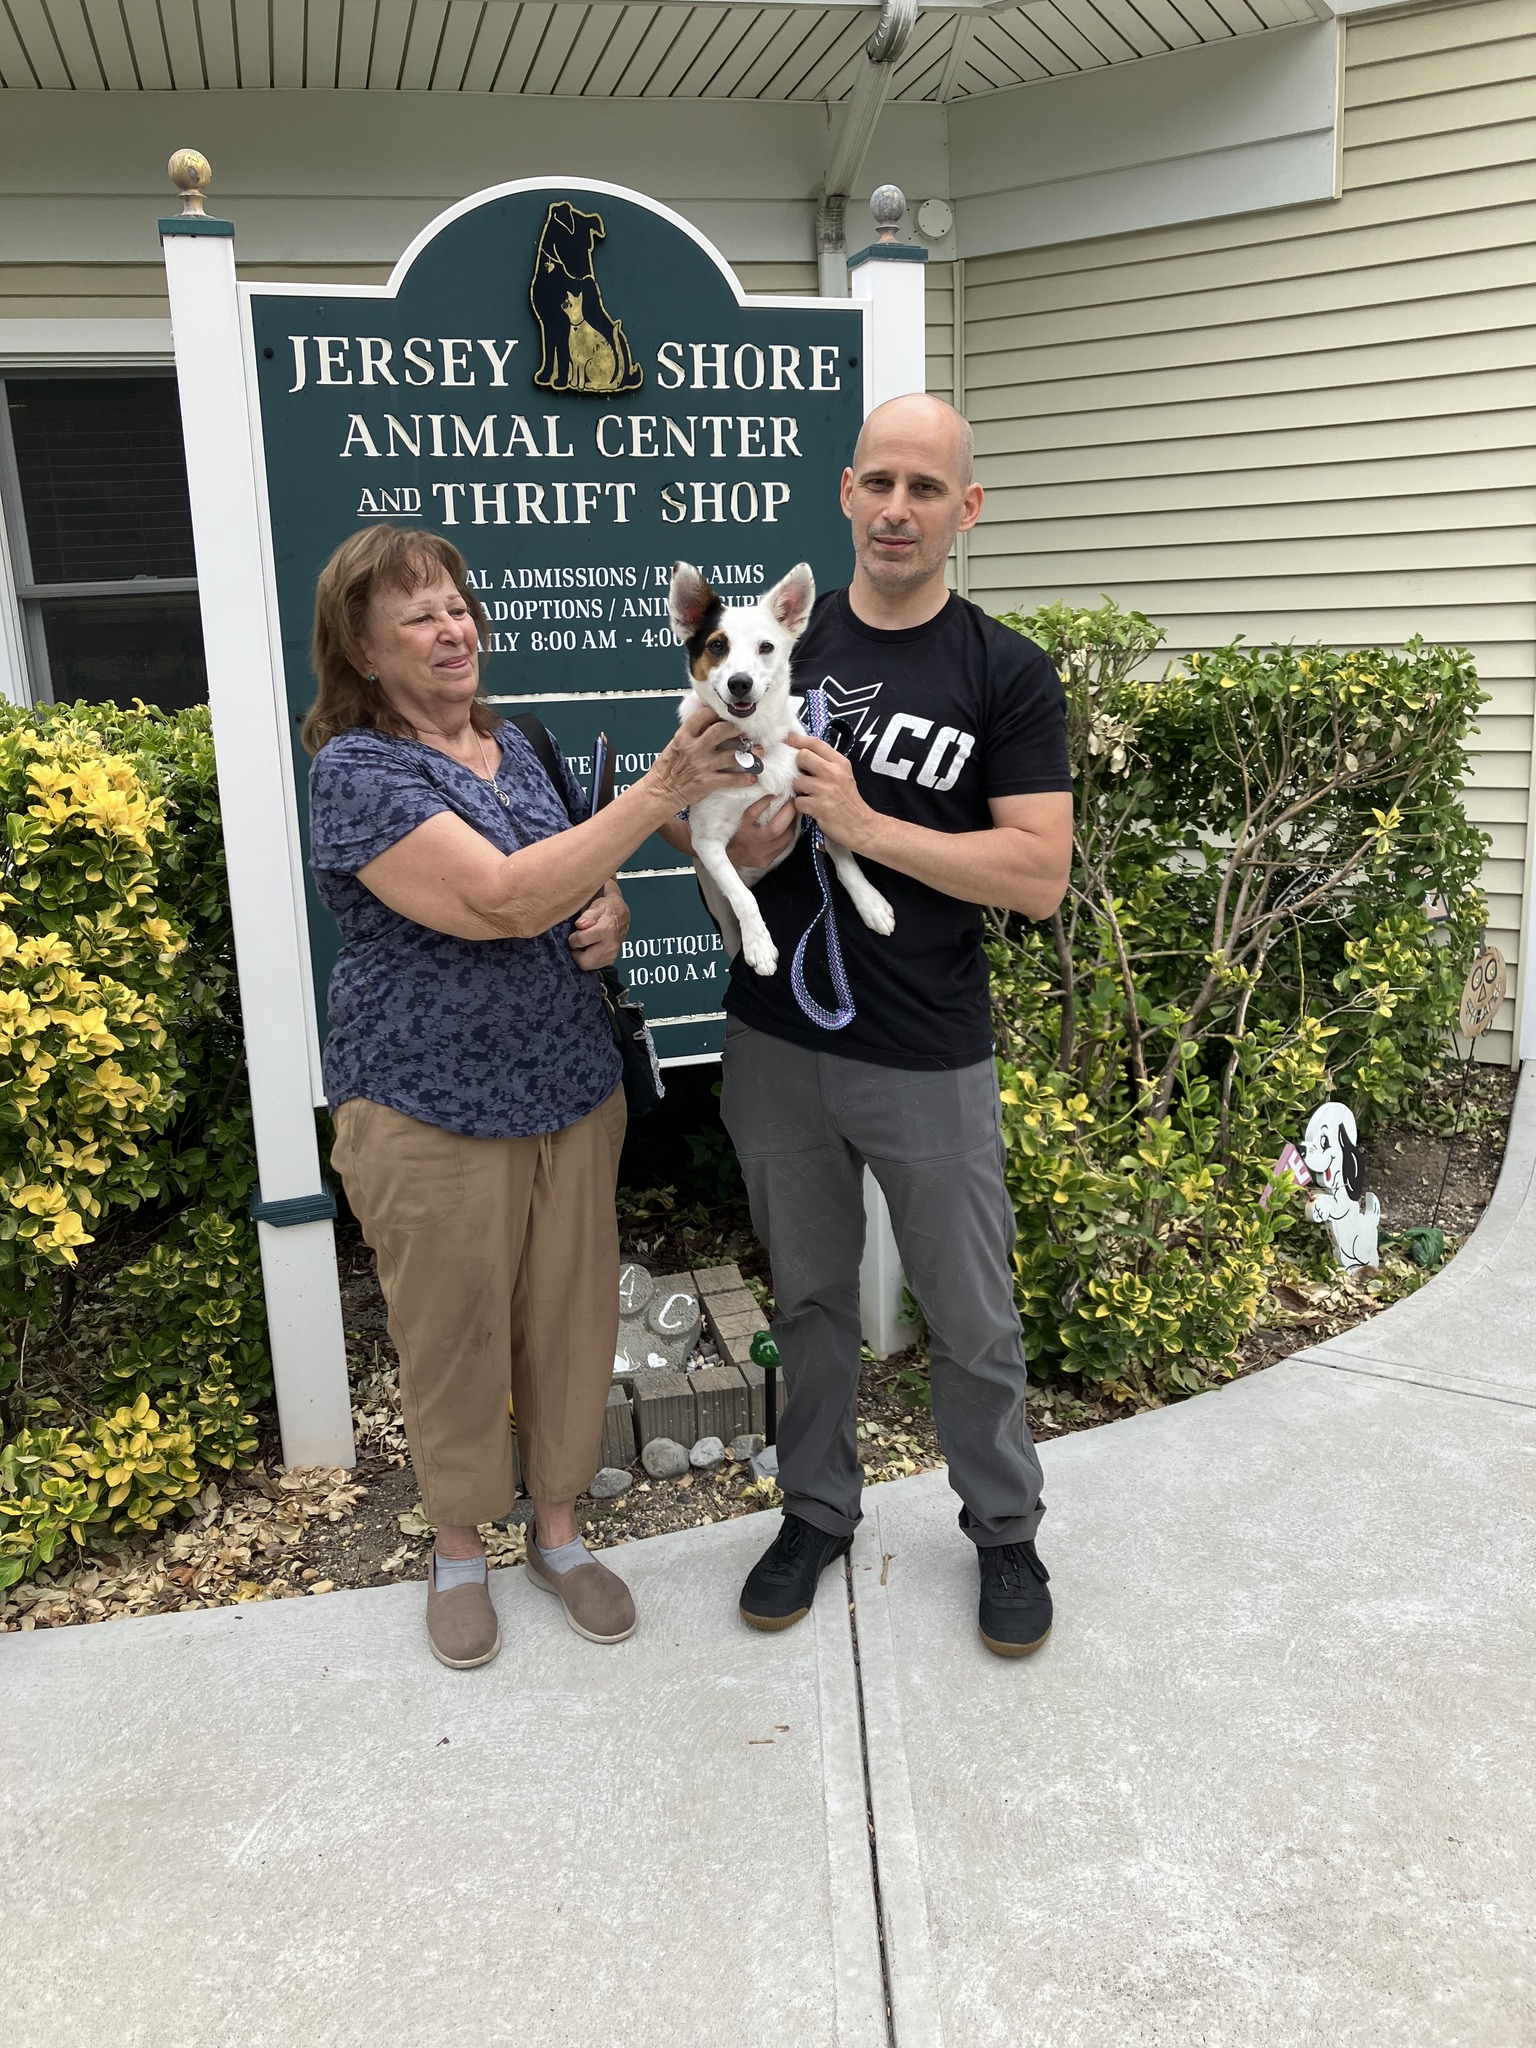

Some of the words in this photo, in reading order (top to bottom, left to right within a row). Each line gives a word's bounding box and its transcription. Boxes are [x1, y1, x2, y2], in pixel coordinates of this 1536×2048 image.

[288, 335, 519, 393] JERSEY
[656, 341, 841, 391] SHORE
[339, 413, 575, 458] ANIMAL
[595, 414, 803, 458] CENTER
[357, 488, 423, 513] AND
[432, 482, 636, 524] THRIFT
[661, 481, 791, 523] SHOP
[501, 566, 637, 589] ADMISSIONS
[654, 564, 765, 586] RAIMS
[530, 630, 577, 652] 8:00
[581, 629, 617, 650] AM
[621, 933, 724, 959] BOUTIQUE
[628, 964, 680, 986] 10:00
